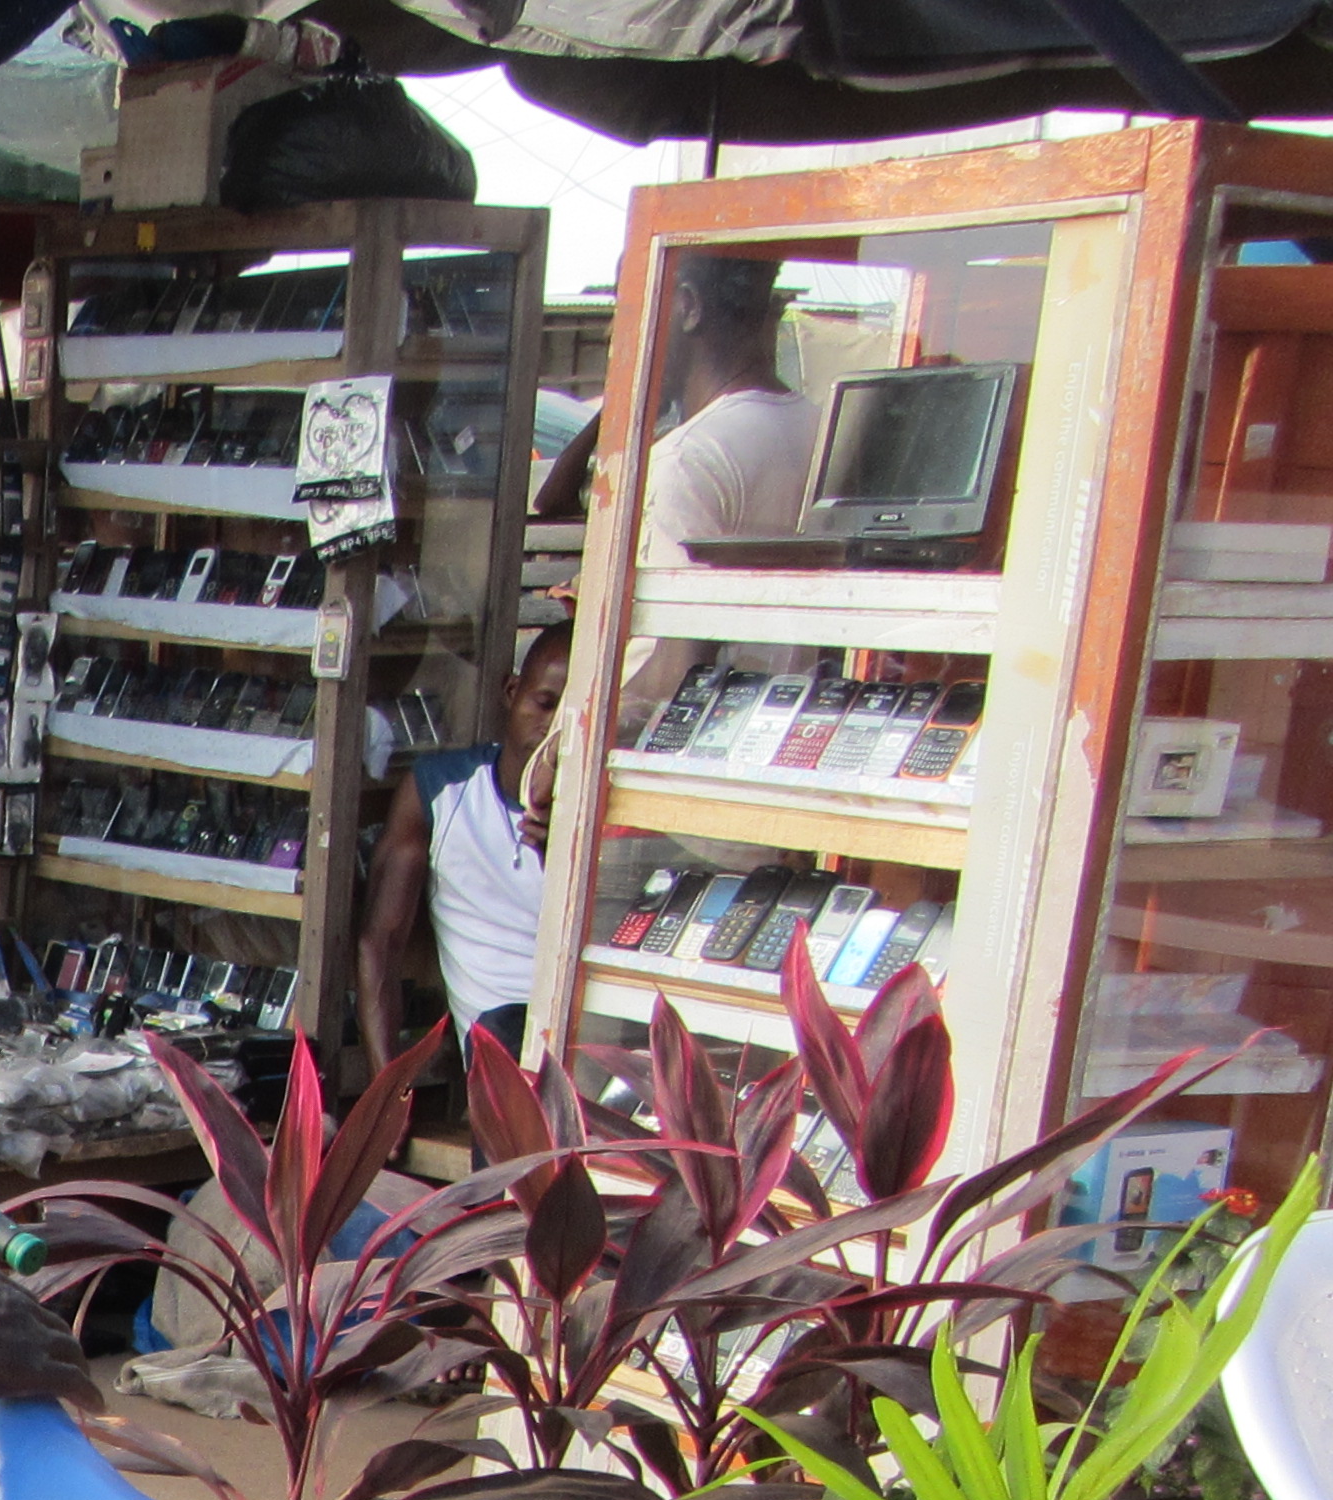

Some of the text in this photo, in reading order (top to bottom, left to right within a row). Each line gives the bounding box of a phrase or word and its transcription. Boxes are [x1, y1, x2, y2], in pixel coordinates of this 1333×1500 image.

[1035, 361, 1082, 593] Enjoy the communication
[983, 740, 1026, 958] Enjoy the communication
[952, 1098, 974, 1143] Enjoy
